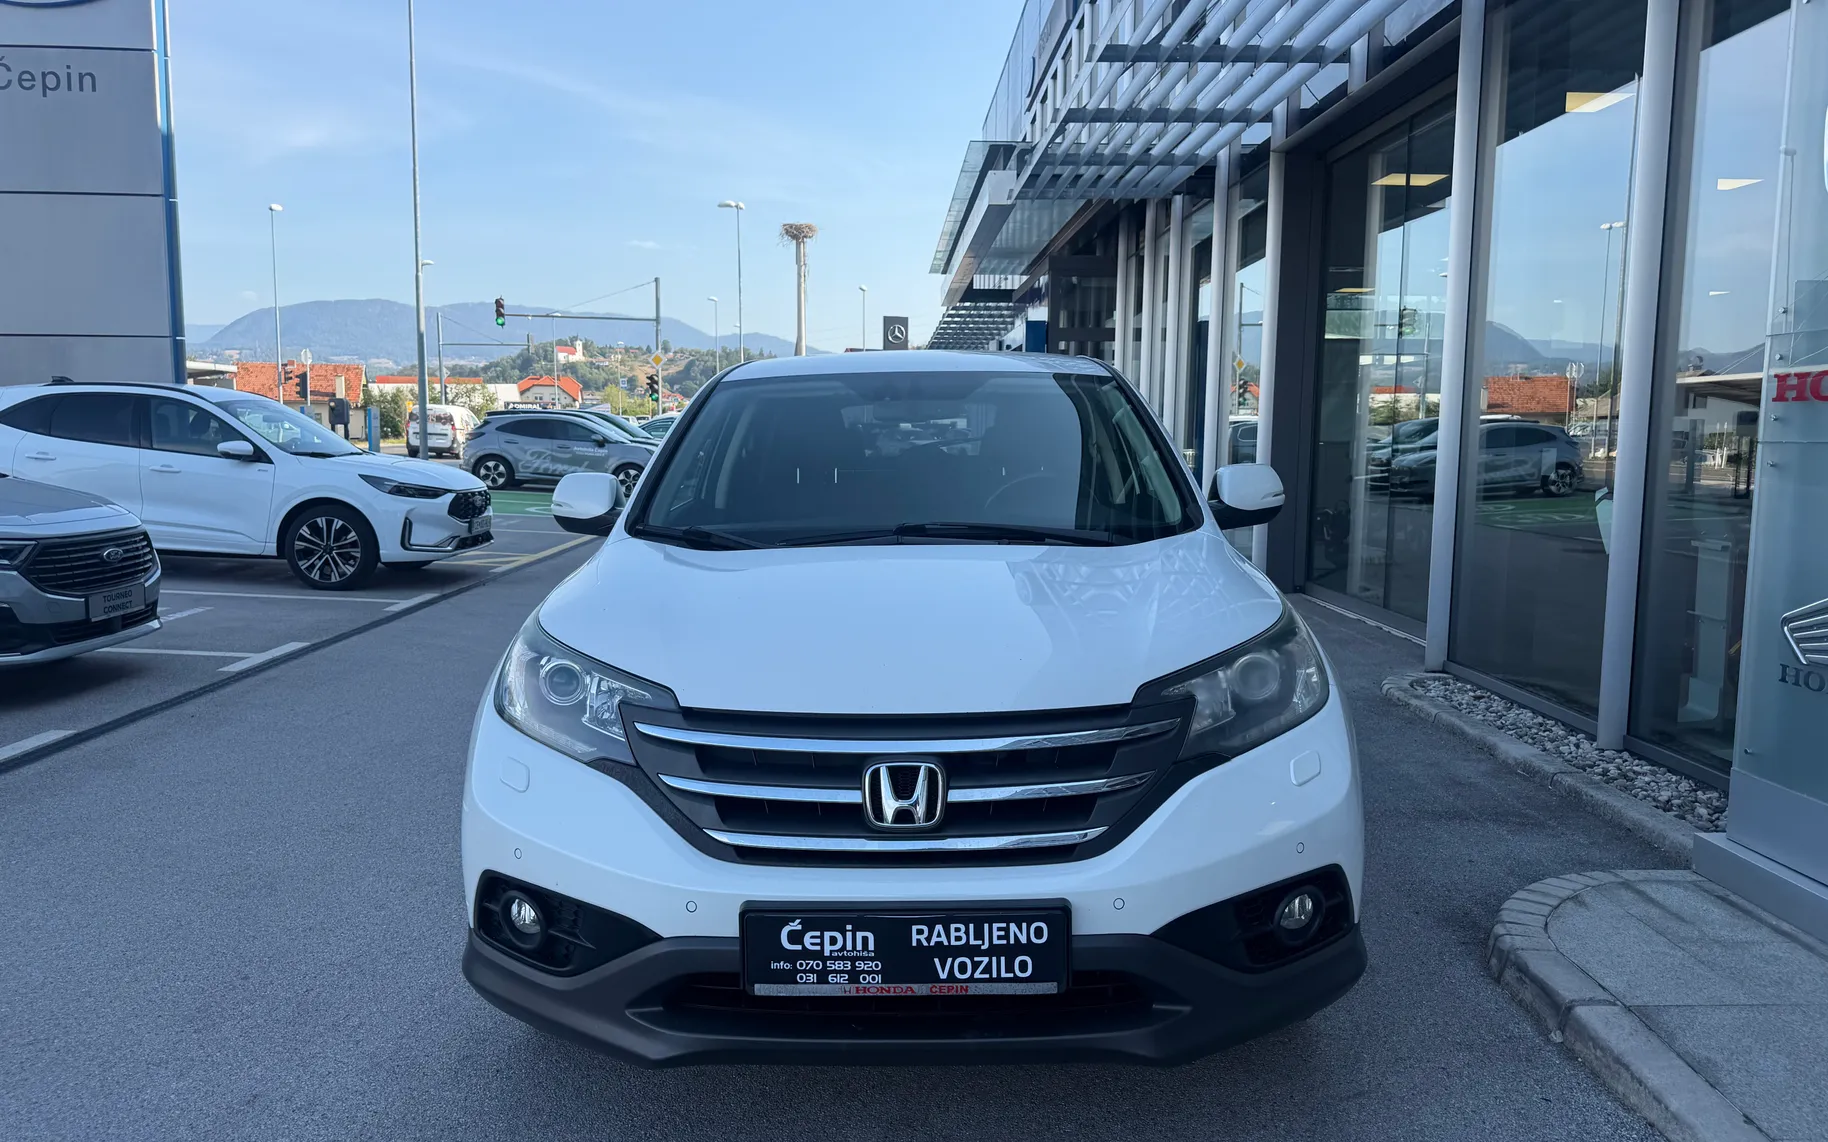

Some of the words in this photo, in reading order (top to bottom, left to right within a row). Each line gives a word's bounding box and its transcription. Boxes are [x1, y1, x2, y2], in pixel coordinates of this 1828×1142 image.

[103, 589, 132, 603] TOURNEO
[103, 600, 132, 614] CONNECT
[780, 919, 875, 956] Čepin
[911, 921, 1049, 950] RABLJENO
[770, 961, 793, 970] info:
[796, 961, 823, 970] 070
[826, 961, 851, 971] 583
[855, 961, 882, 971] 920
[933, 955, 1033, 980] VOZILO
[796, 973, 817, 983] 031
[828, 973, 849, 984] 612
[859, 974, 882, 984] 001
[855, 986, 917, 994] HONDA
